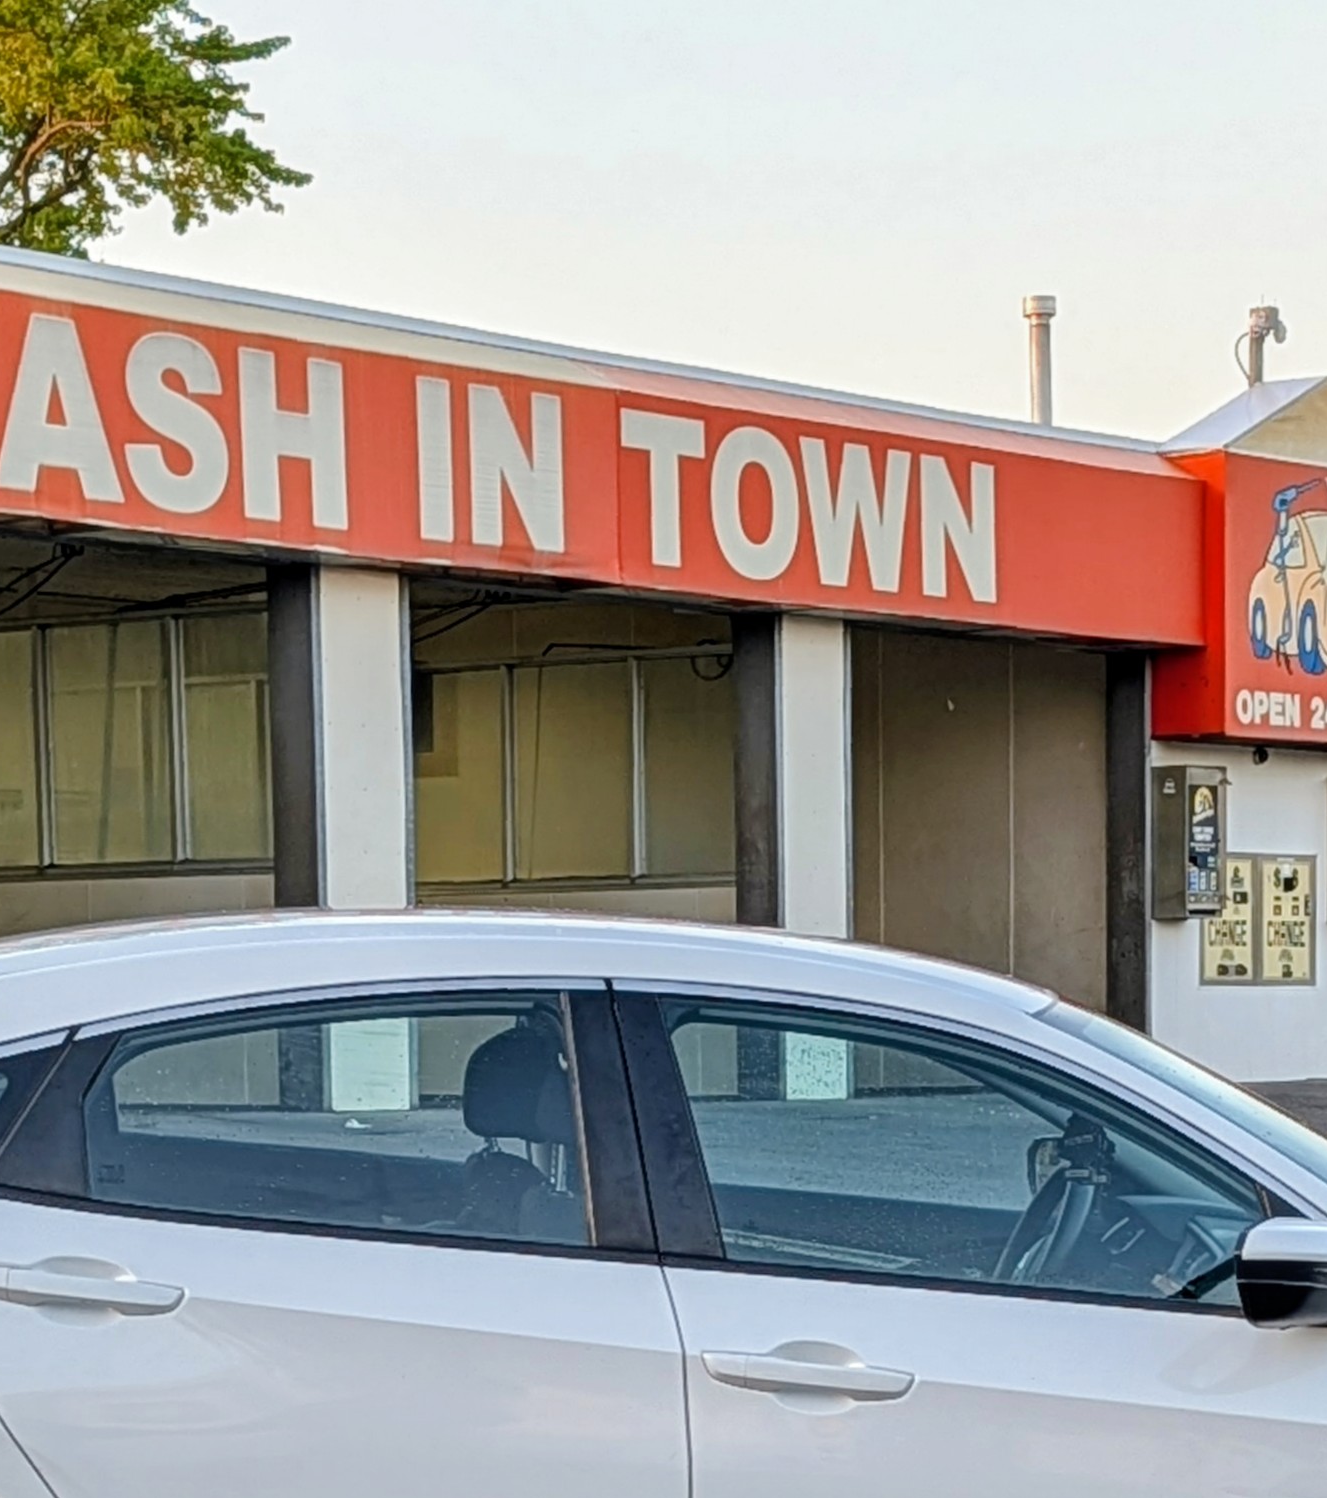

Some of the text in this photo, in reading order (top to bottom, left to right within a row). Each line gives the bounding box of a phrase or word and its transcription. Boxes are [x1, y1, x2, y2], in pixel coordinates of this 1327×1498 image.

[415, 375, 565, 553] IN
[619, 406, 997, 602] TOWN
[1236, 689, 1301, 728] OPEN
